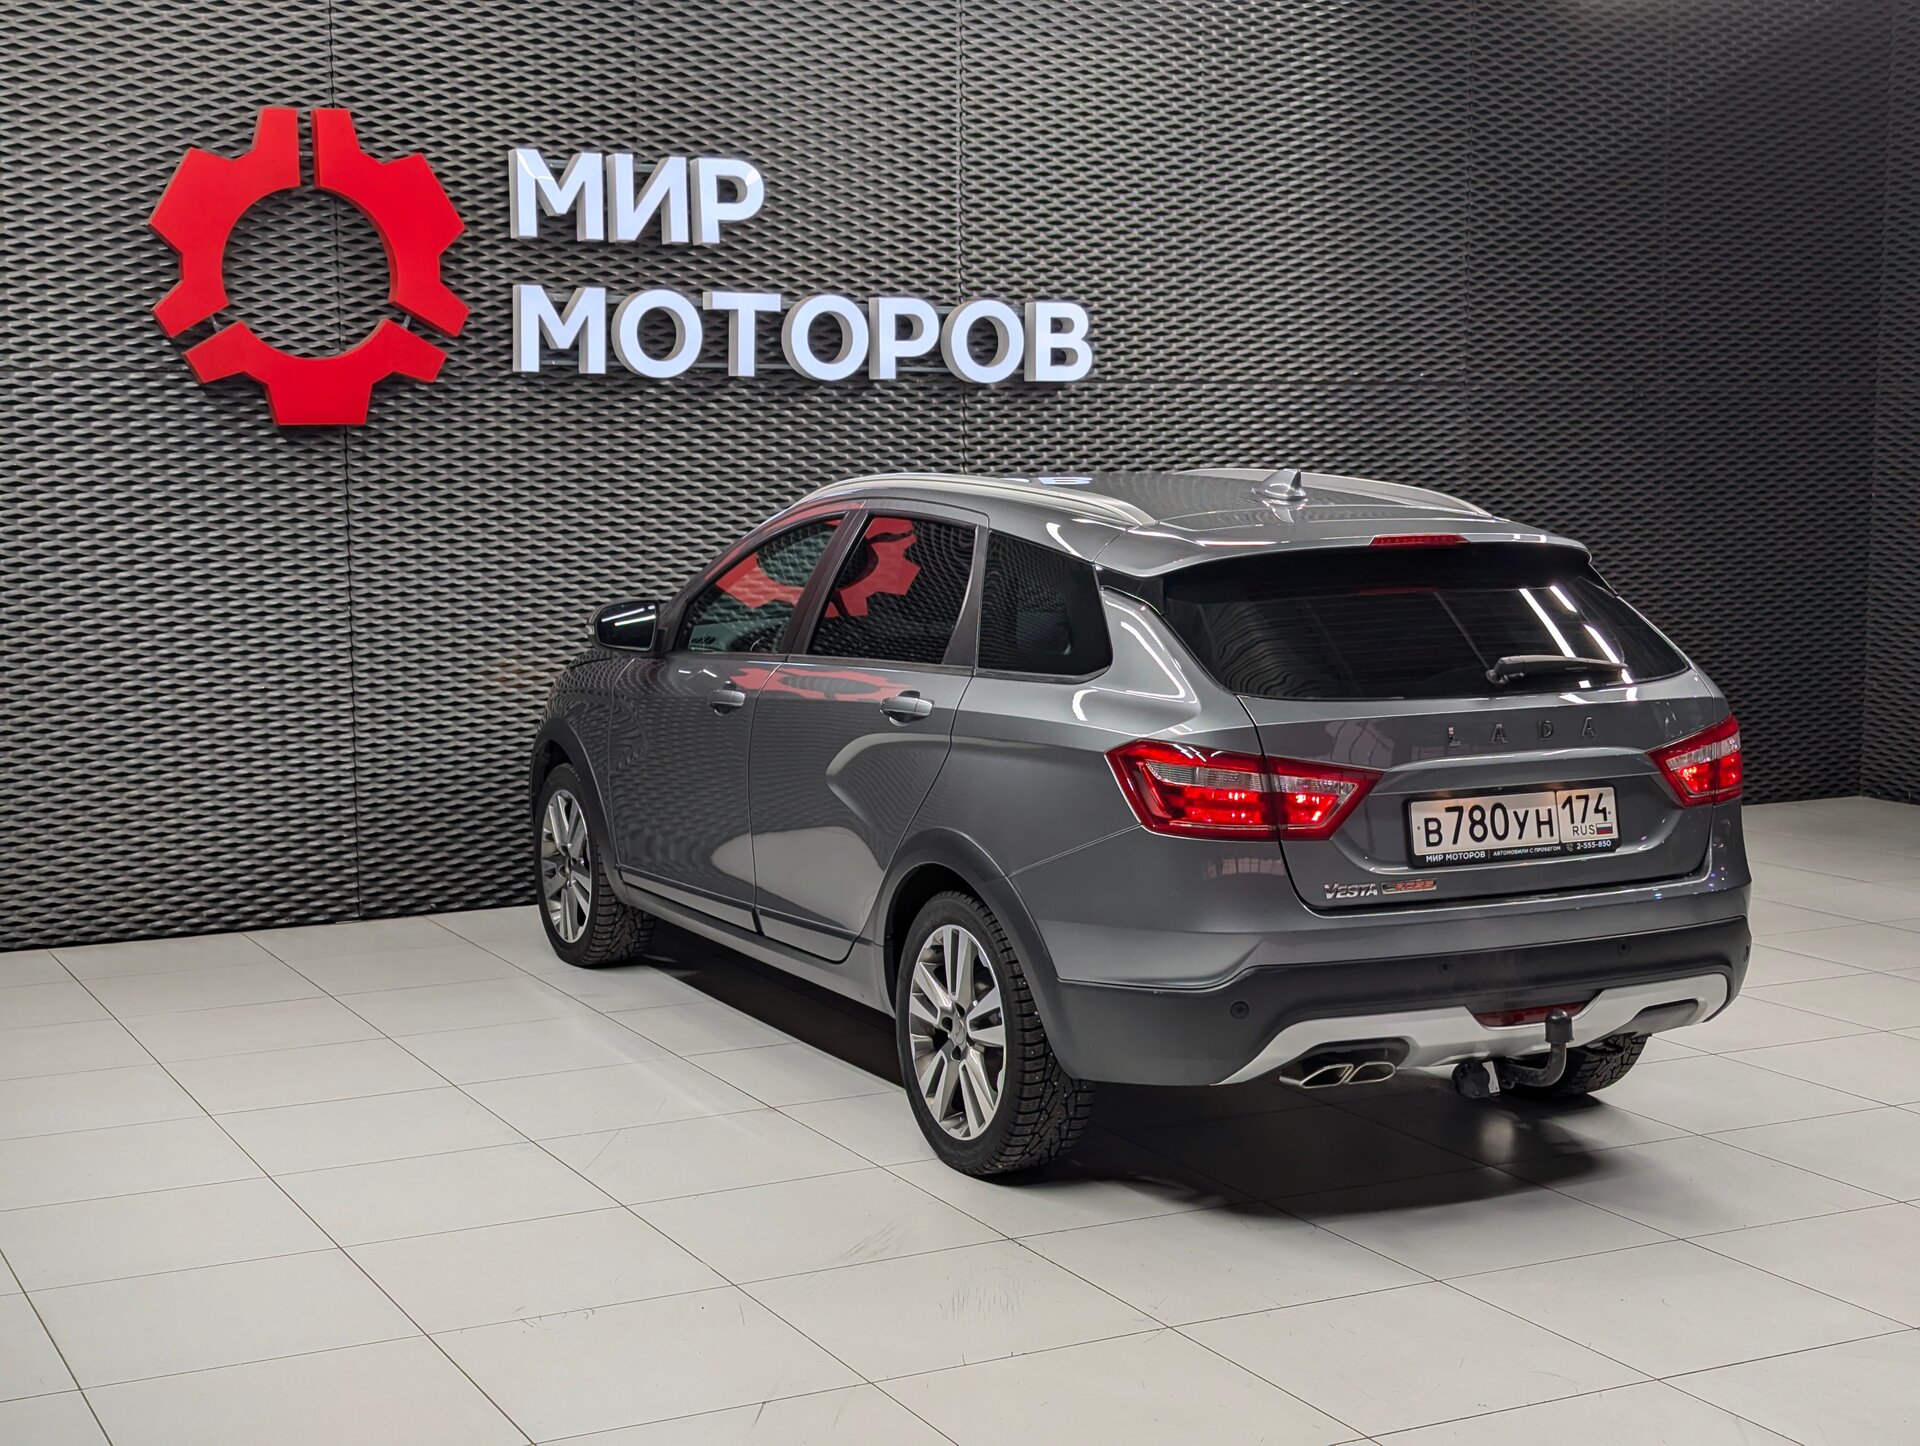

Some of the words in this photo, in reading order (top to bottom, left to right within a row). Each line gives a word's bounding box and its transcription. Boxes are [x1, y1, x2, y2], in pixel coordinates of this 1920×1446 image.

[508, 148, 765, 246] МИР
[512, 284, 1093, 383] МОТОРОВ
[1448, 716, 1596, 746] LADA
[1424, 802, 1555, 848] В780УН
[1561, 792, 1608, 825] 174
[1572, 824, 1596, 836] RUS
[1493, 848, 1529, 857] АВТОМОБИЛИ
[1576, 839, 1612, 850] 2-555-850
[1426, 854, 1444, 863] МИР
[1446, 850, 1486, 861] МОТОРОВ
[1324, 883, 1378, 899] VESTA
